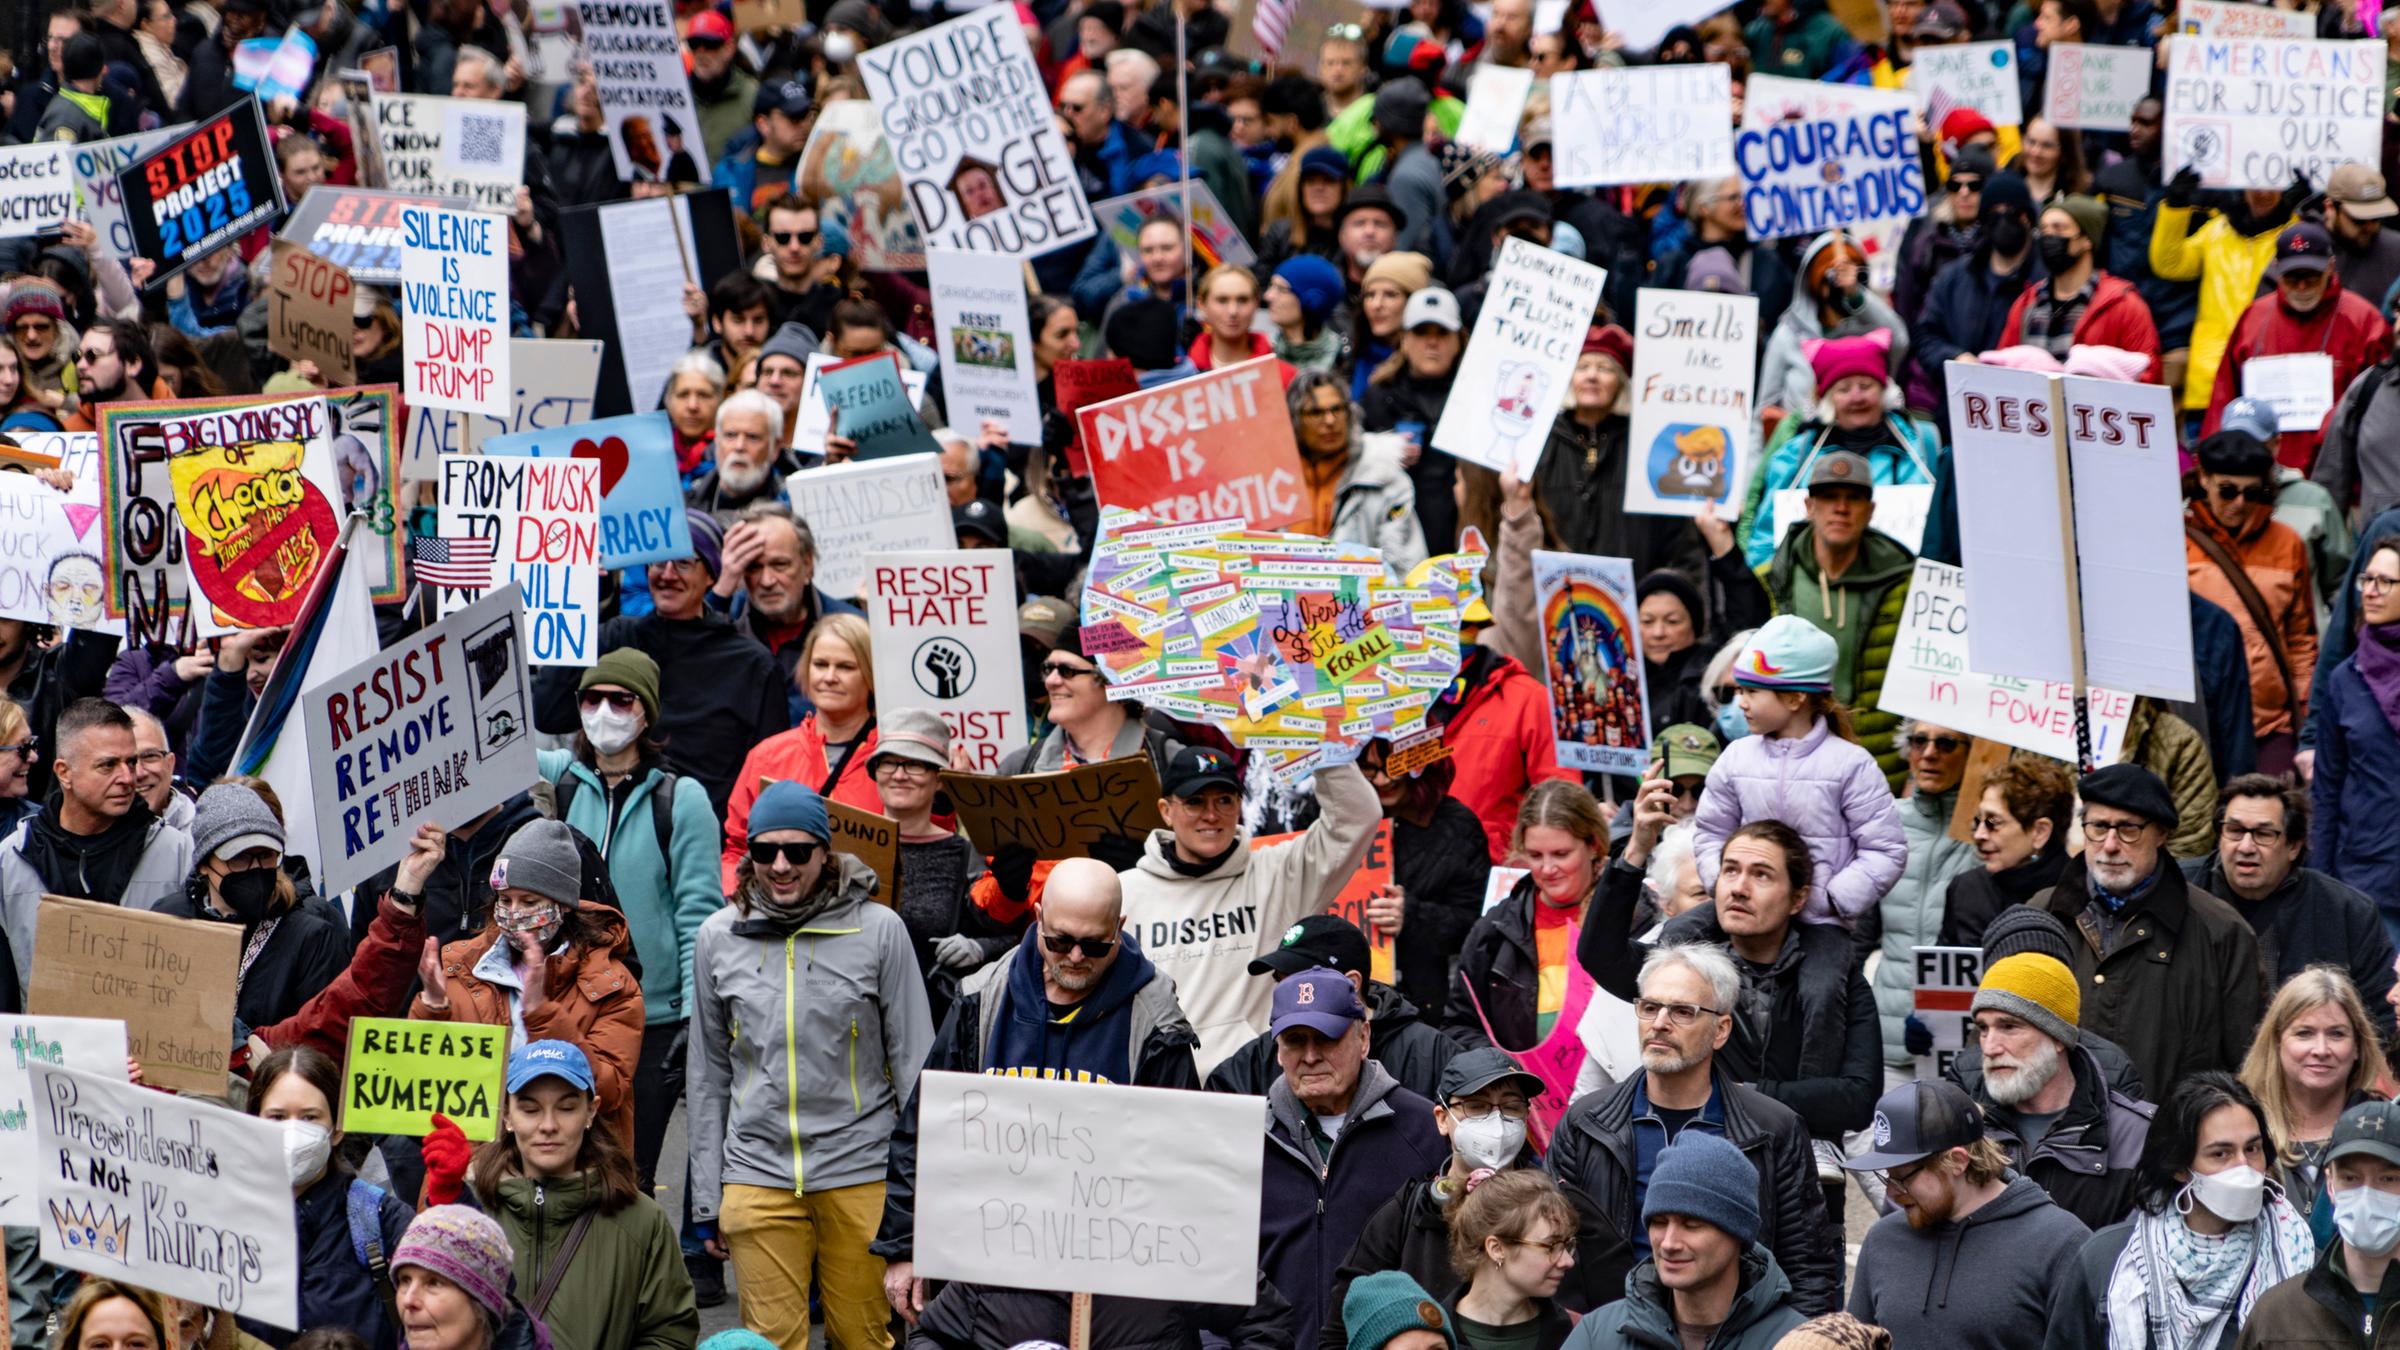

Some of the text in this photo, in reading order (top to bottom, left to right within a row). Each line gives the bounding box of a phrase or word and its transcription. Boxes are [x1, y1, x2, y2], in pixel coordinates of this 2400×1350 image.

[581, 1, 667, 27] REMOVE
[586, 34, 678, 53] OLIGARCHS
[866, 14, 1017, 98] YOU'RE
[2184, 43, 2373, 83] AMERICANS
[594, 60, 657, 80] FACISTS
[600, 86, 687, 108] DICTATORS
[2174, 78, 2381, 117] FOR JUSTICE
[898, 92, 1047, 174] GO TO THE
[1600, 107, 1692, 147] WORLD
[1740, 108, 1918, 182] COURAGE
[2281, 119, 2341, 151] OUR
[0, 153, 60, 180] otect
[144, 115, 235, 198] STOP
[388, 159, 432, 180] OUR
[151, 155, 244, 227] PROJECT
[1744, 162, 1925, 237] CONTAGIOUS
[159, 182, 252, 259] 2025
[402, 209, 492, 256] SILENCE
[286, 252, 350, 306] STOP
[442, 256, 460, 284] IS
[405, 280, 497, 323] VIOLENCE
[959, 311, 1002, 328] RESIST
[1508, 297, 1576, 333] FLUSH
[1645, 300, 1745, 343] Smells
[275, 289, 350, 370] Tyranny
[426, 322, 492, 364] DUMP
[1684, 348, 1723, 371] like
[414, 361, 494, 403] TRUMP
[827, 377, 896, 411] DEFEND
[1641, 372, 1748, 421] Fascism
[161, 402, 323, 457] BIG LYING SAC
[1094, 368, 1261, 462] DISSENT
[1963, 391, 2156, 449] RESIST
[224, 446, 255, 466] OF
[1165, 437, 1206, 483] IS
[444, 460, 599, 513] FROM MUSK
[801, 477, 904, 532] HANDS
[1100, 466, 1299, 525] TRIOTIC
[0, 531, 50, 560] UCK
[515, 516, 597, 566] DON
[875, 564, 995, 597] RESIST
[887, 597, 988, 626] HATE
[1201, 602, 1240, 633] HANDS
[1272, 591, 1361, 643] Liberty
[533, 611, 586, 660] ON
[1309, 611, 1375, 659] JUSTICE
[1325, 634, 1392, 678] FOR ALL
[327, 634, 447, 752] RESIST
[1912, 637, 2129, 719] than PEPLE
[1929, 677, 1958, 705] in
[949, 711, 1011, 741] SIST
[335, 695, 455, 803] REMOVE
[1574, 747, 1637, 767] NO EXCEPTIONS
[342, 749, 471, 861] RETHINK
[947, 769, 1140, 810] UNPLUG
[826, 813, 890, 847] OUND
[990, 799, 1151, 852] MUSK
[1135, 905, 1256, 949] I DISSENT
[66, 914, 192, 986] First they
[91, 966, 179, 1008] came for
[1296, 982, 1315, 1005] B
[10, 1023, 65, 1070] the
[157, 1036, 225, 1072] students
[362, 1028, 495, 1060] RELEASE
[352, 1066, 491, 1119] RÜMEYSA
[45, 1071, 220, 1179] Presidents
[961, 1089, 1096, 1176] Rights
[60, 1150, 132, 1199] R Not
[1071, 1170, 1134, 1209] NOT
[142, 1180, 264, 1315] Kings
[979, 1198, 1202, 1268] PRIVLEDGES
